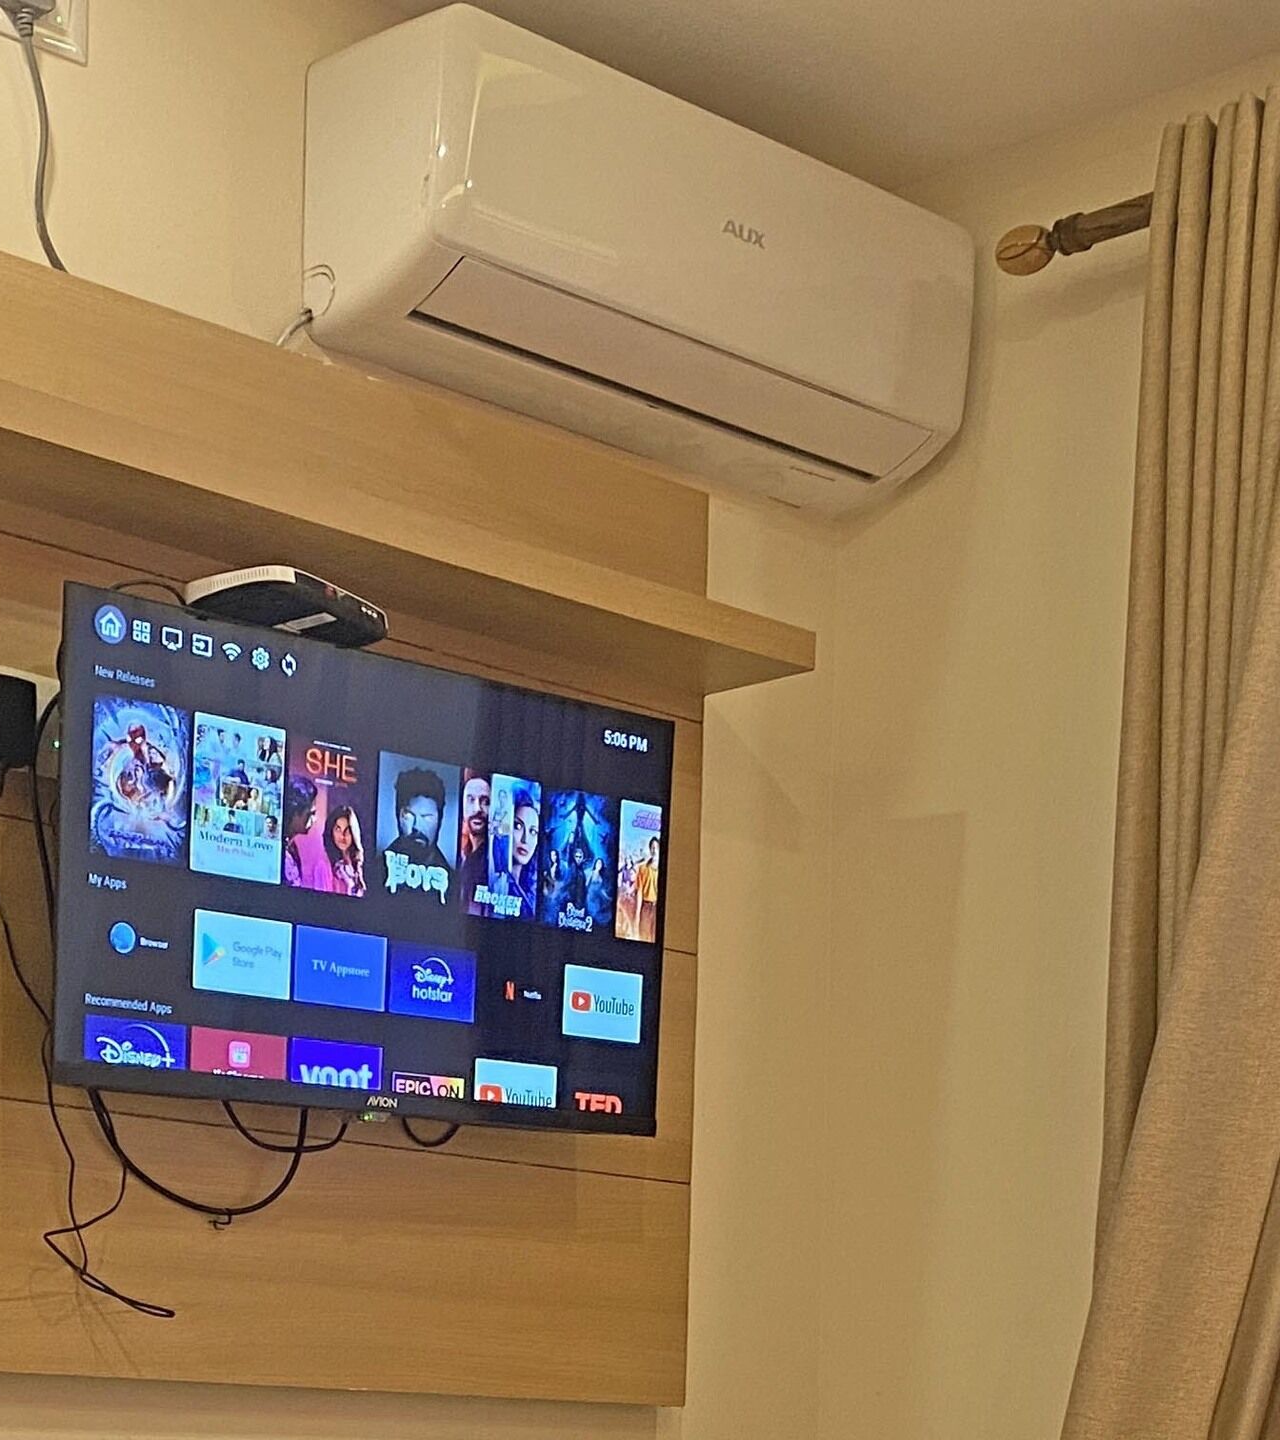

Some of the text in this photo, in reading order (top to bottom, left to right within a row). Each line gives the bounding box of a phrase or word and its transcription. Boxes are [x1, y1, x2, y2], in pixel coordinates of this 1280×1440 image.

[722, 220, 766, 249] AUX
[95, 665, 156, 688] New Releases
[604, 729, 648, 752] 5:06 PM
[305, 748, 357, 784] SHE
[199, 829, 243, 847] Modern
[246, 838, 274, 852] Love
[384, 850, 410, 866] THE
[88, 873, 127, 891] My Apps
[386, 861, 449, 897] BOYS
[474, 889, 523, 910] BROKEN
[233, 941, 283, 960] Google Play
[232, 957, 254, 969] Store
[312, 959, 370, 978] TV Appstore
[85, 993, 173, 1015] Recommended Apps
[412, 985, 453, 1002] hotstar
[593, 994, 635, 1016] YouTube
[395, 1079, 461, 1099] EPIC ON
[366, 1096, 398, 1108] AVION
